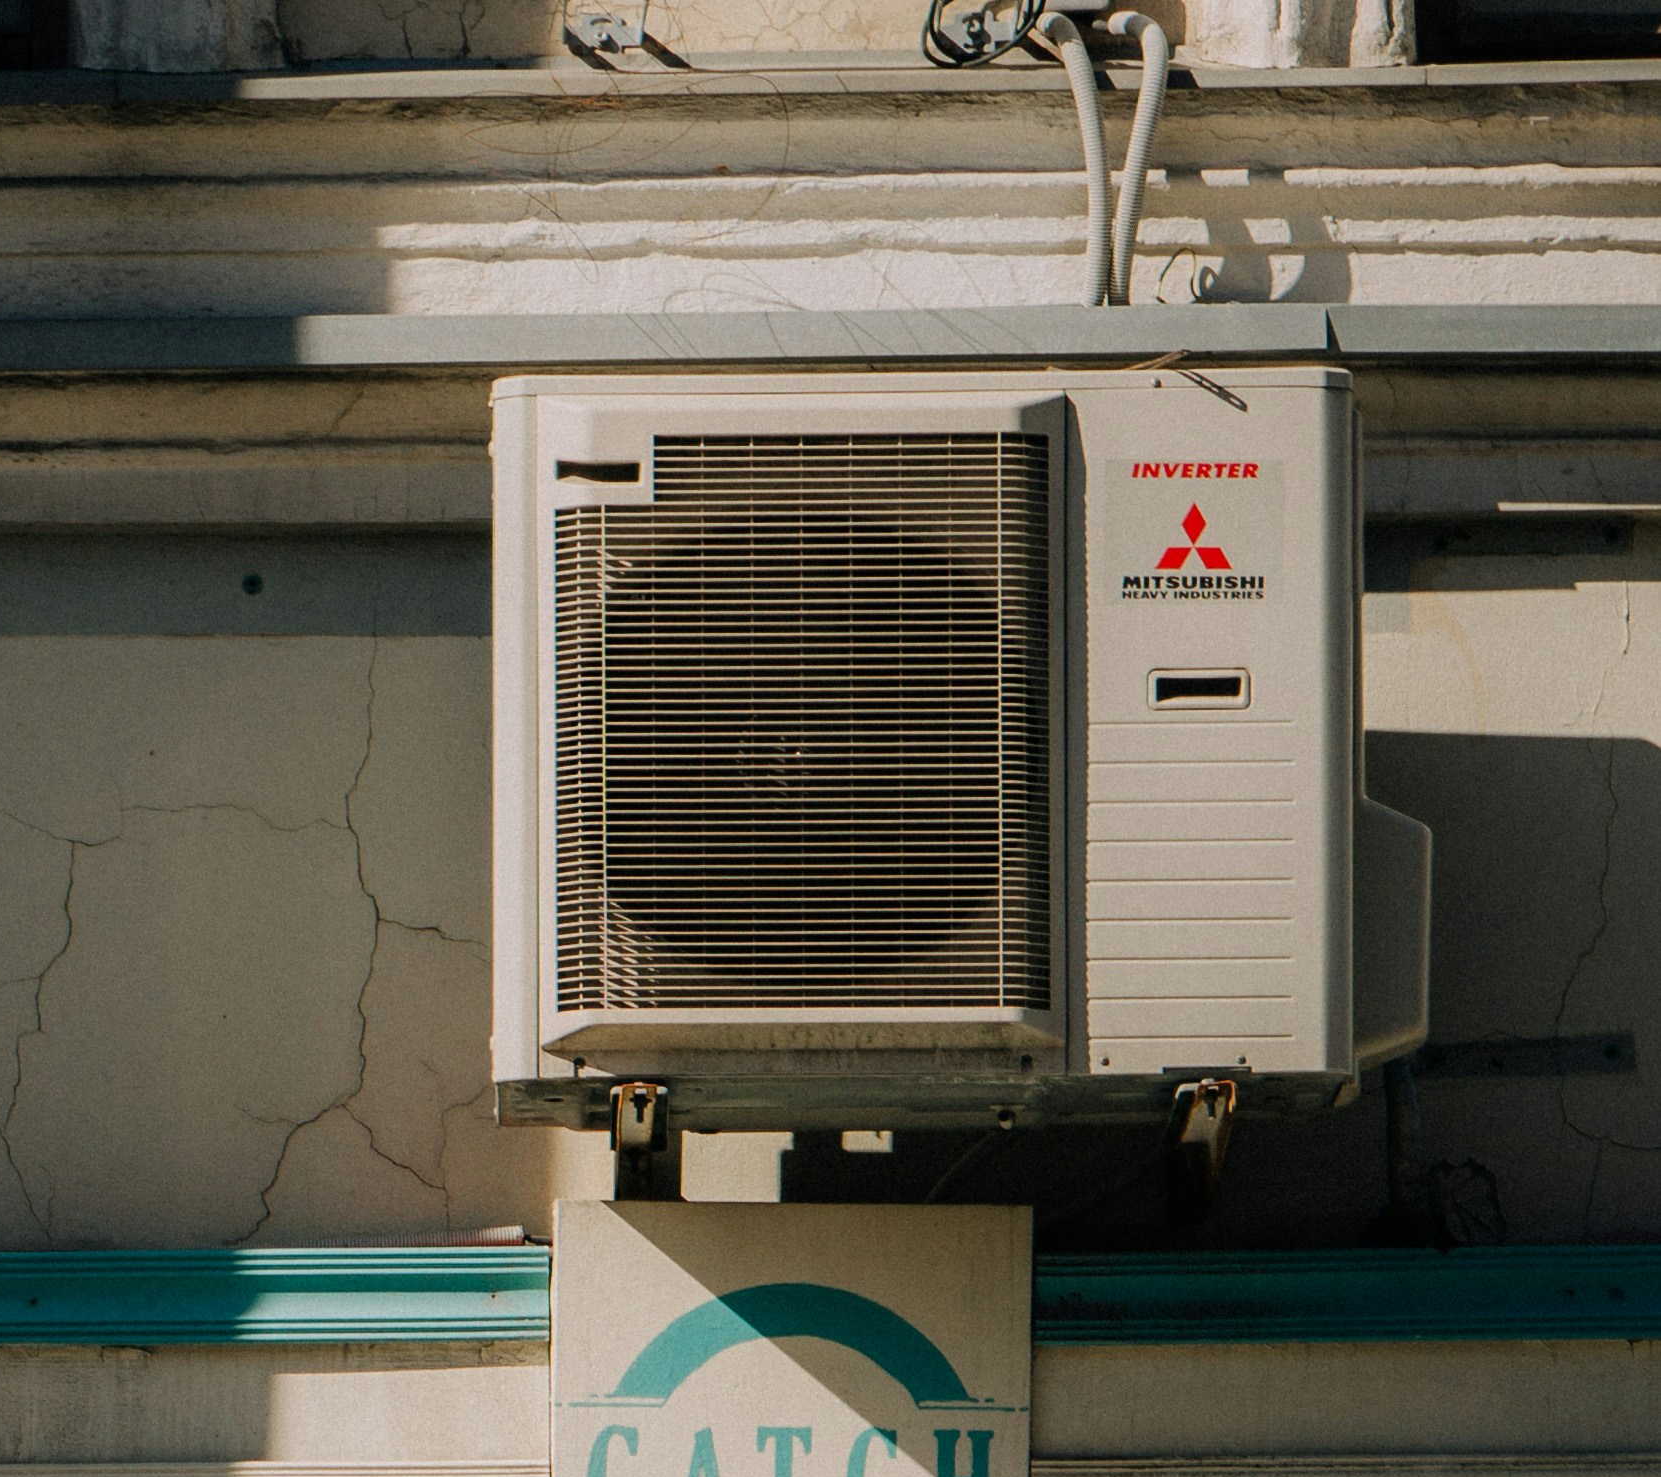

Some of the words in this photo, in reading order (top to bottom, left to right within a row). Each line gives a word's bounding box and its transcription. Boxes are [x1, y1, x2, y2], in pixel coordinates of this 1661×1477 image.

[1131, 462, 1260, 479] INVERTER
[1121, 575, 1265, 589] MITSUBISHI
[1121, 590, 1168, 599] HEAVY
[1173, 590, 1265, 599] INDUSTRIES
